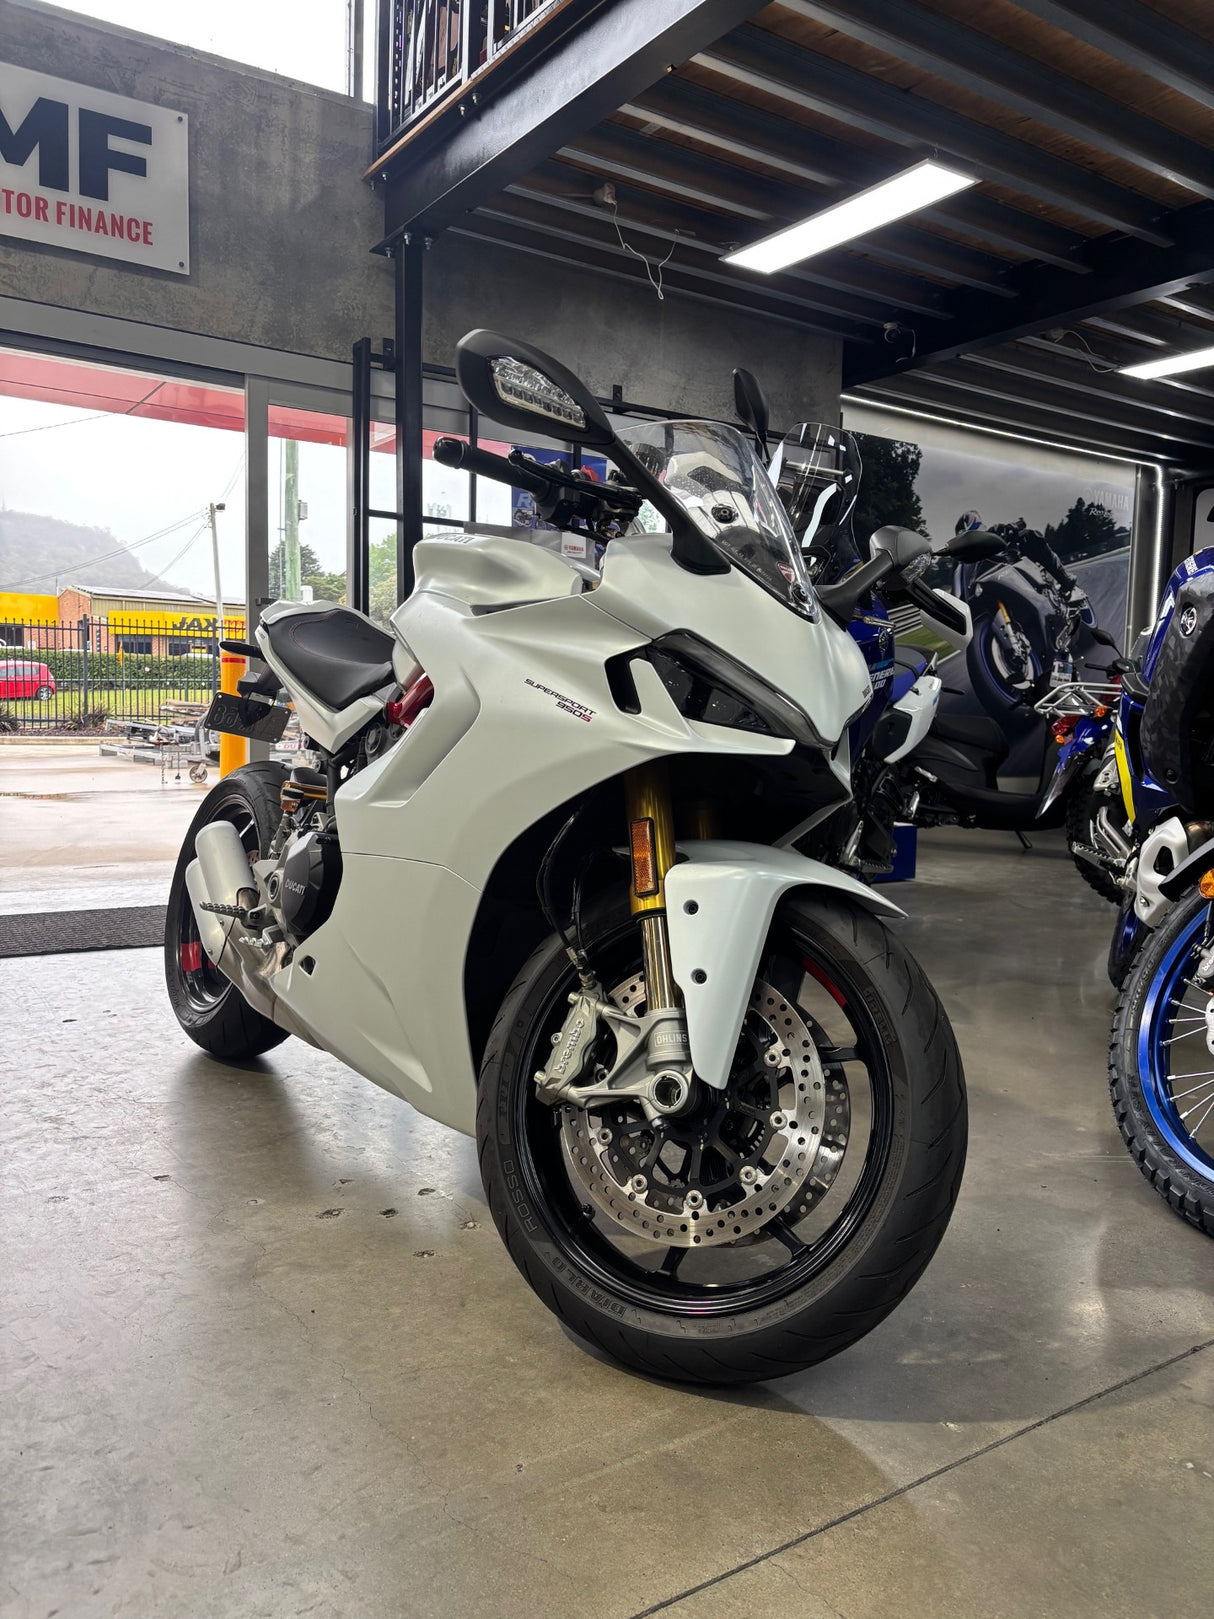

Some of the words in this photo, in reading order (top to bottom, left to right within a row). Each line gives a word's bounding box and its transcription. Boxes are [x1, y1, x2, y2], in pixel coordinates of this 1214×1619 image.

[56, 201, 153, 246] FINANCE
[172, 616, 217, 632] JAX
[524, 678, 597, 715] SUPERSPORT
[872, 678, 887, 690] 00
[285, 879, 306, 896] DUCATI
[553, 1018, 585, 1075] brembo
[503, 1159, 538, 1233] ROSSO
[551, 1256, 627, 1318] DIABLO
